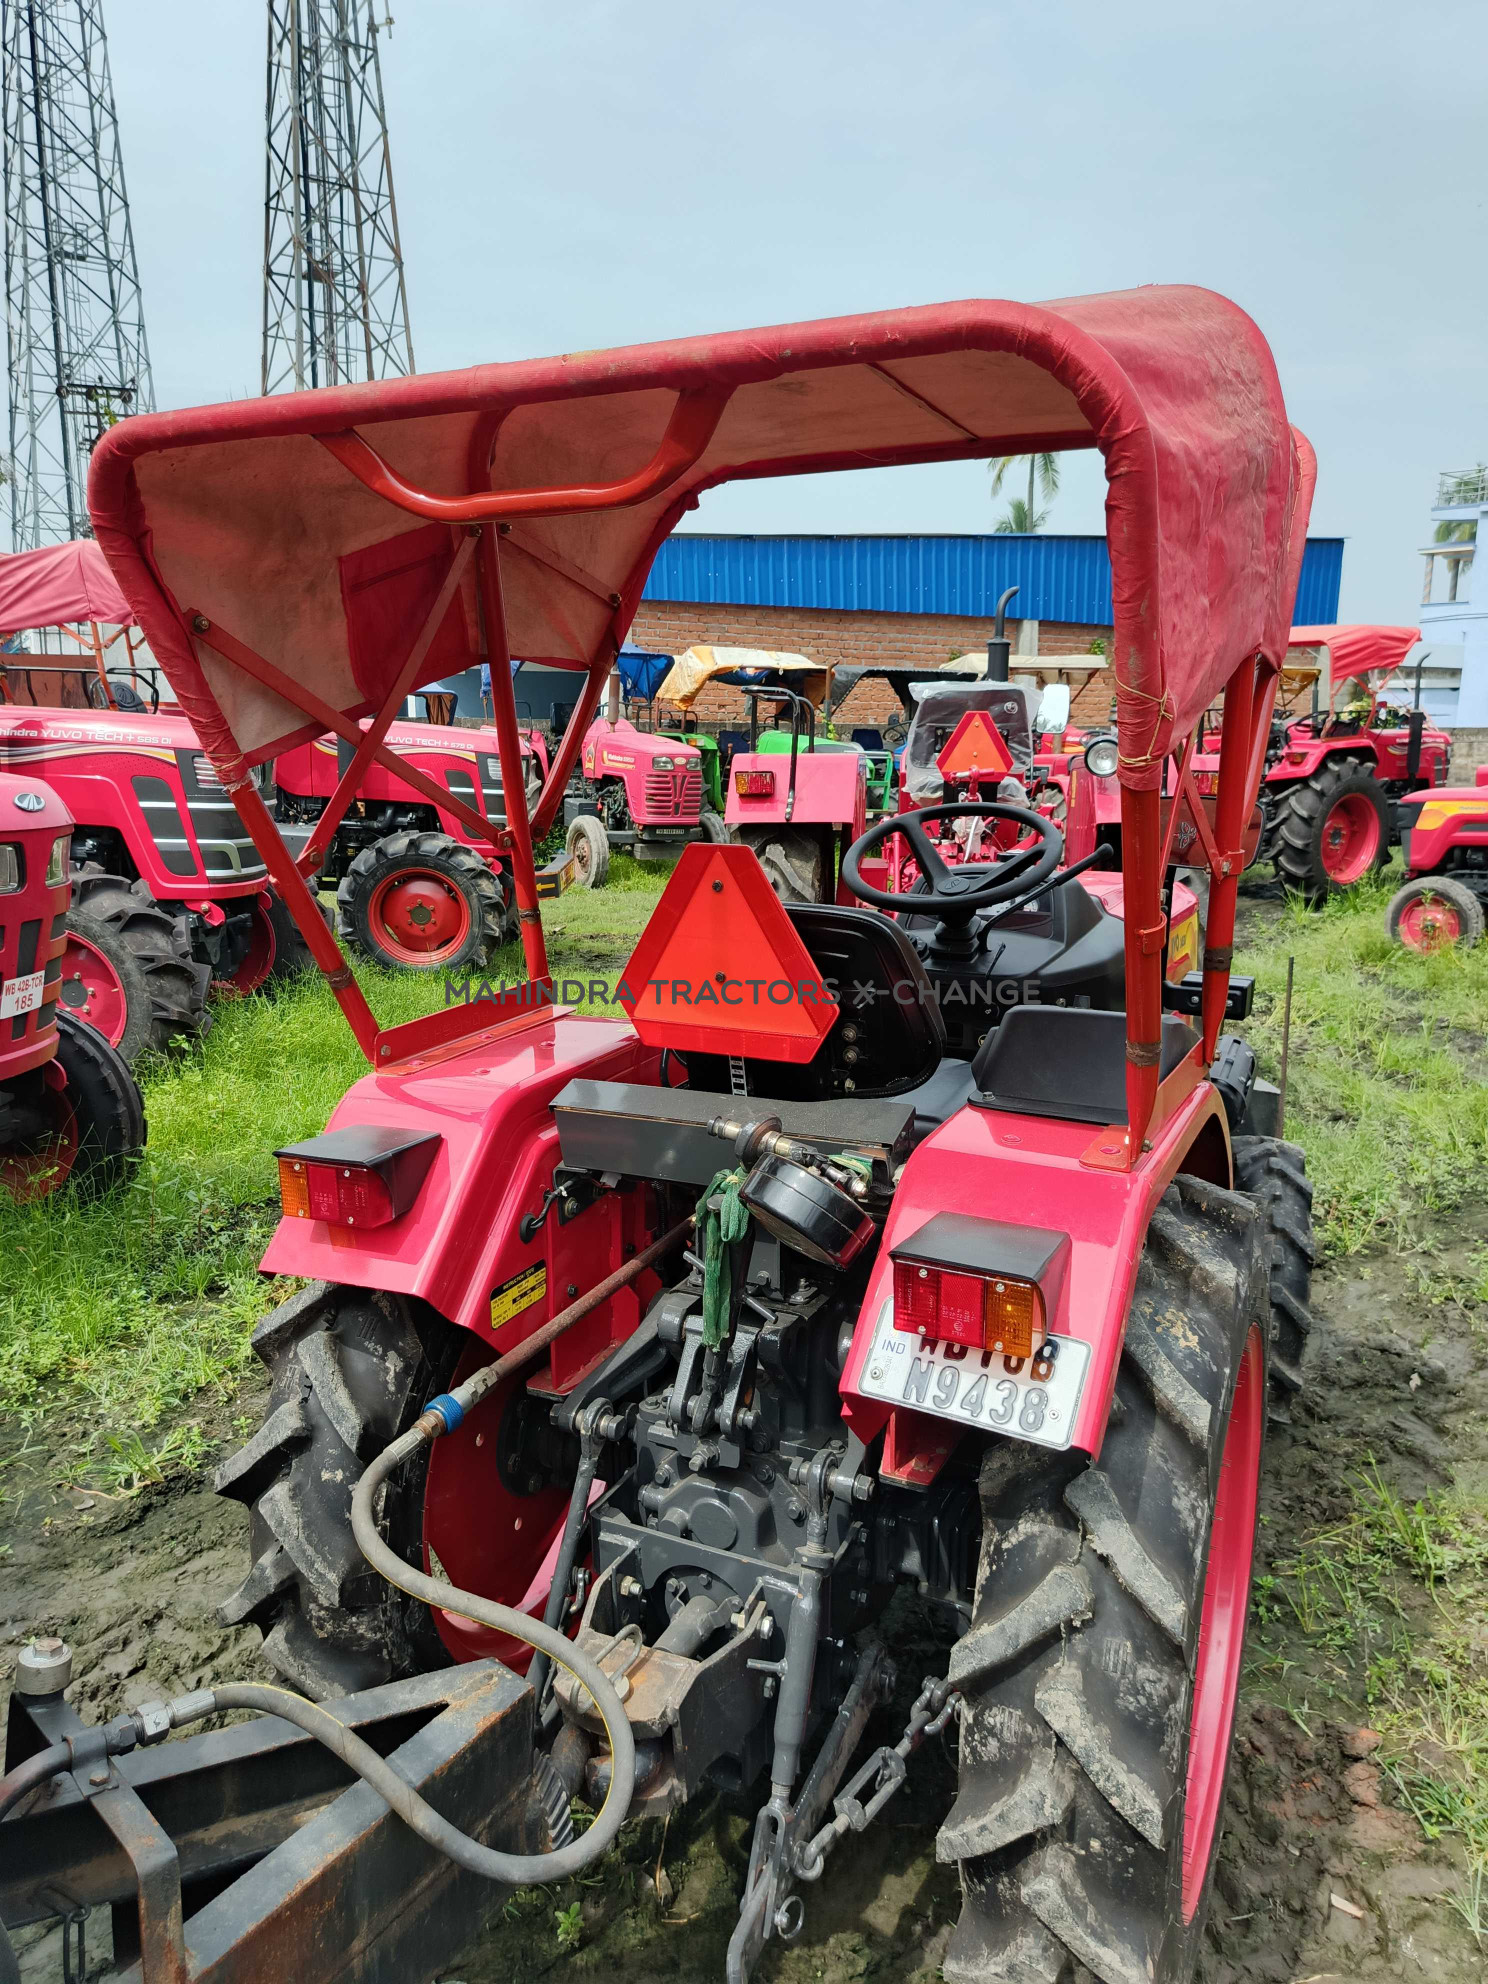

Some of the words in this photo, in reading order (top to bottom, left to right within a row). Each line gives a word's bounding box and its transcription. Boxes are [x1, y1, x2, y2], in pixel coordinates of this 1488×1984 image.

[41, 728, 82, 740] YUVO
[86, 730, 123, 742] TECH
[416, 737, 441, 746] TECH
[5, 983, 16, 997] WB
[15, 993, 34, 1012] 185
[881, 1338, 906, 1355] IND
[902, 1356, 1049, 1433] N9438
